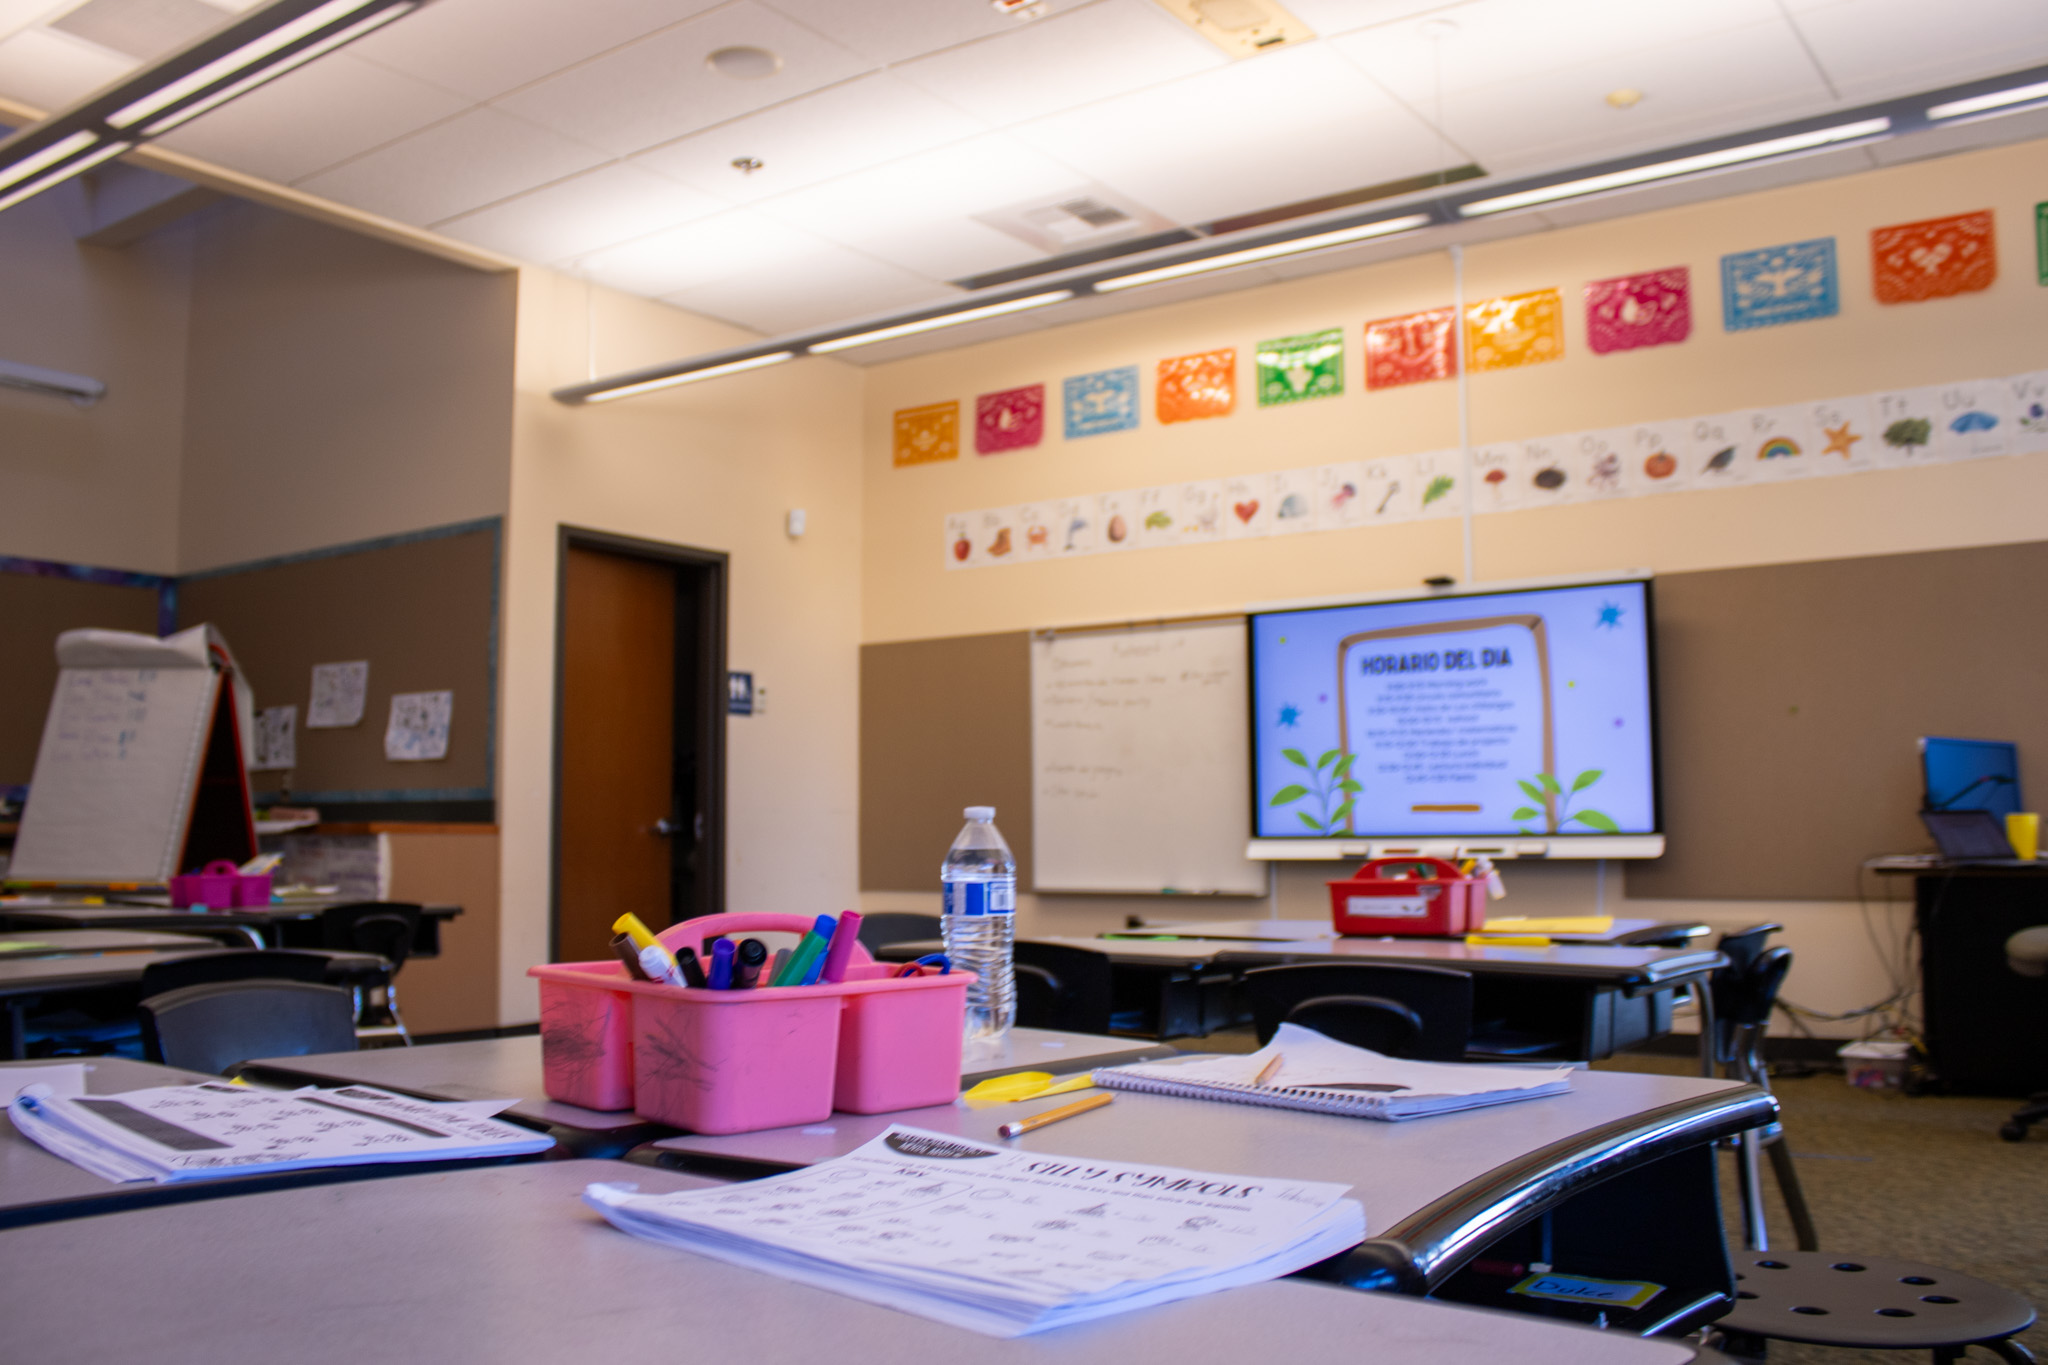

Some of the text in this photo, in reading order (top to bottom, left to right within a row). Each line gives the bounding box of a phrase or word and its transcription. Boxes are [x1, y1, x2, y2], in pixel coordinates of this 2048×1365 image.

[1362, 647, 1513, 675] HORARIO DEL DIA
[1107, 1171, 1264, 1199] SYMBOLS
[1533, 1280, 1615, 1299] Dulce
